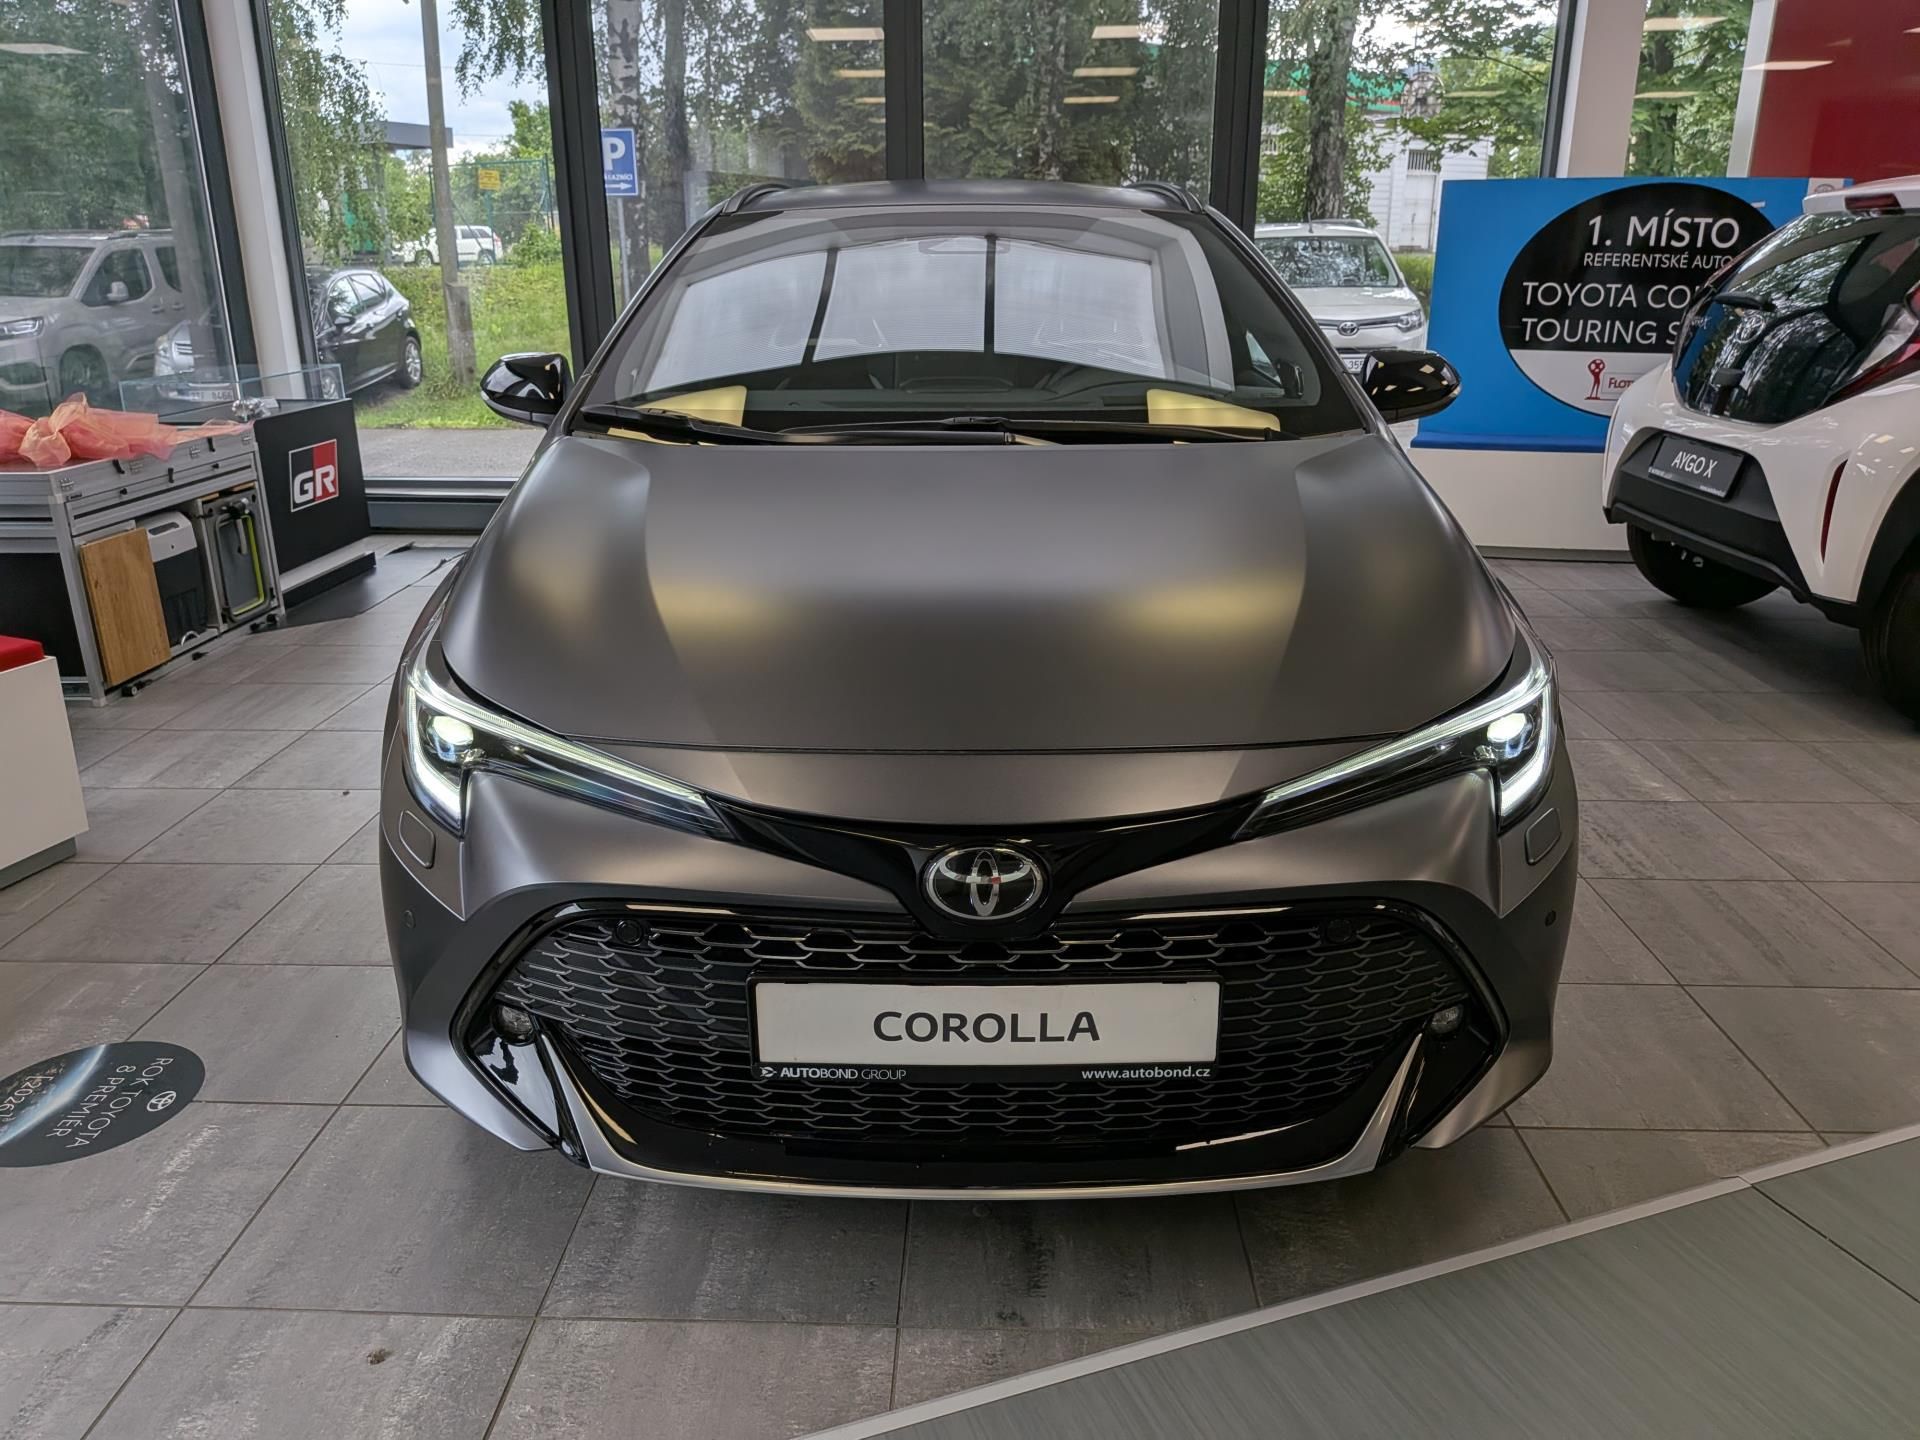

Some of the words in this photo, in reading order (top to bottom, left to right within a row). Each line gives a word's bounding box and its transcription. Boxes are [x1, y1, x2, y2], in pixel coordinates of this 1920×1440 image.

[602, 137, 626, 170] P
[1588, 215, 1612, 246] 1.
[1626, 208, 1740, 249] MÍSTO
[1583, 252, 1689, 269] REFERENTSKÉ
[1523, 282, 1638, 308] TOYOTA
[1647, 285, 1700, 309] CO
[1522, 318, 1657, 345] TOURING
[1608, 377, 1635, 389] FLOT
[1671, 451, 1706, 475] AYGO
[1703, 459, 1718, 478] X
[293, 464, 336, 504] GR
[873, 1011, 1100, 1043] COROLLA
[116, 1065, 136, 1073] 8
[130, 1058, 174, 1086] ROK
[780, 1067, 858, 1080] AUTOBOND
[861, 1069, 907, 1080] GROUP
[1081, 1066, 1211, 1079] www.autobond.cz
[46, 1077, 125, 1137] PREMIÉR
[65, 1090, 143, 1148] TOYOTA
